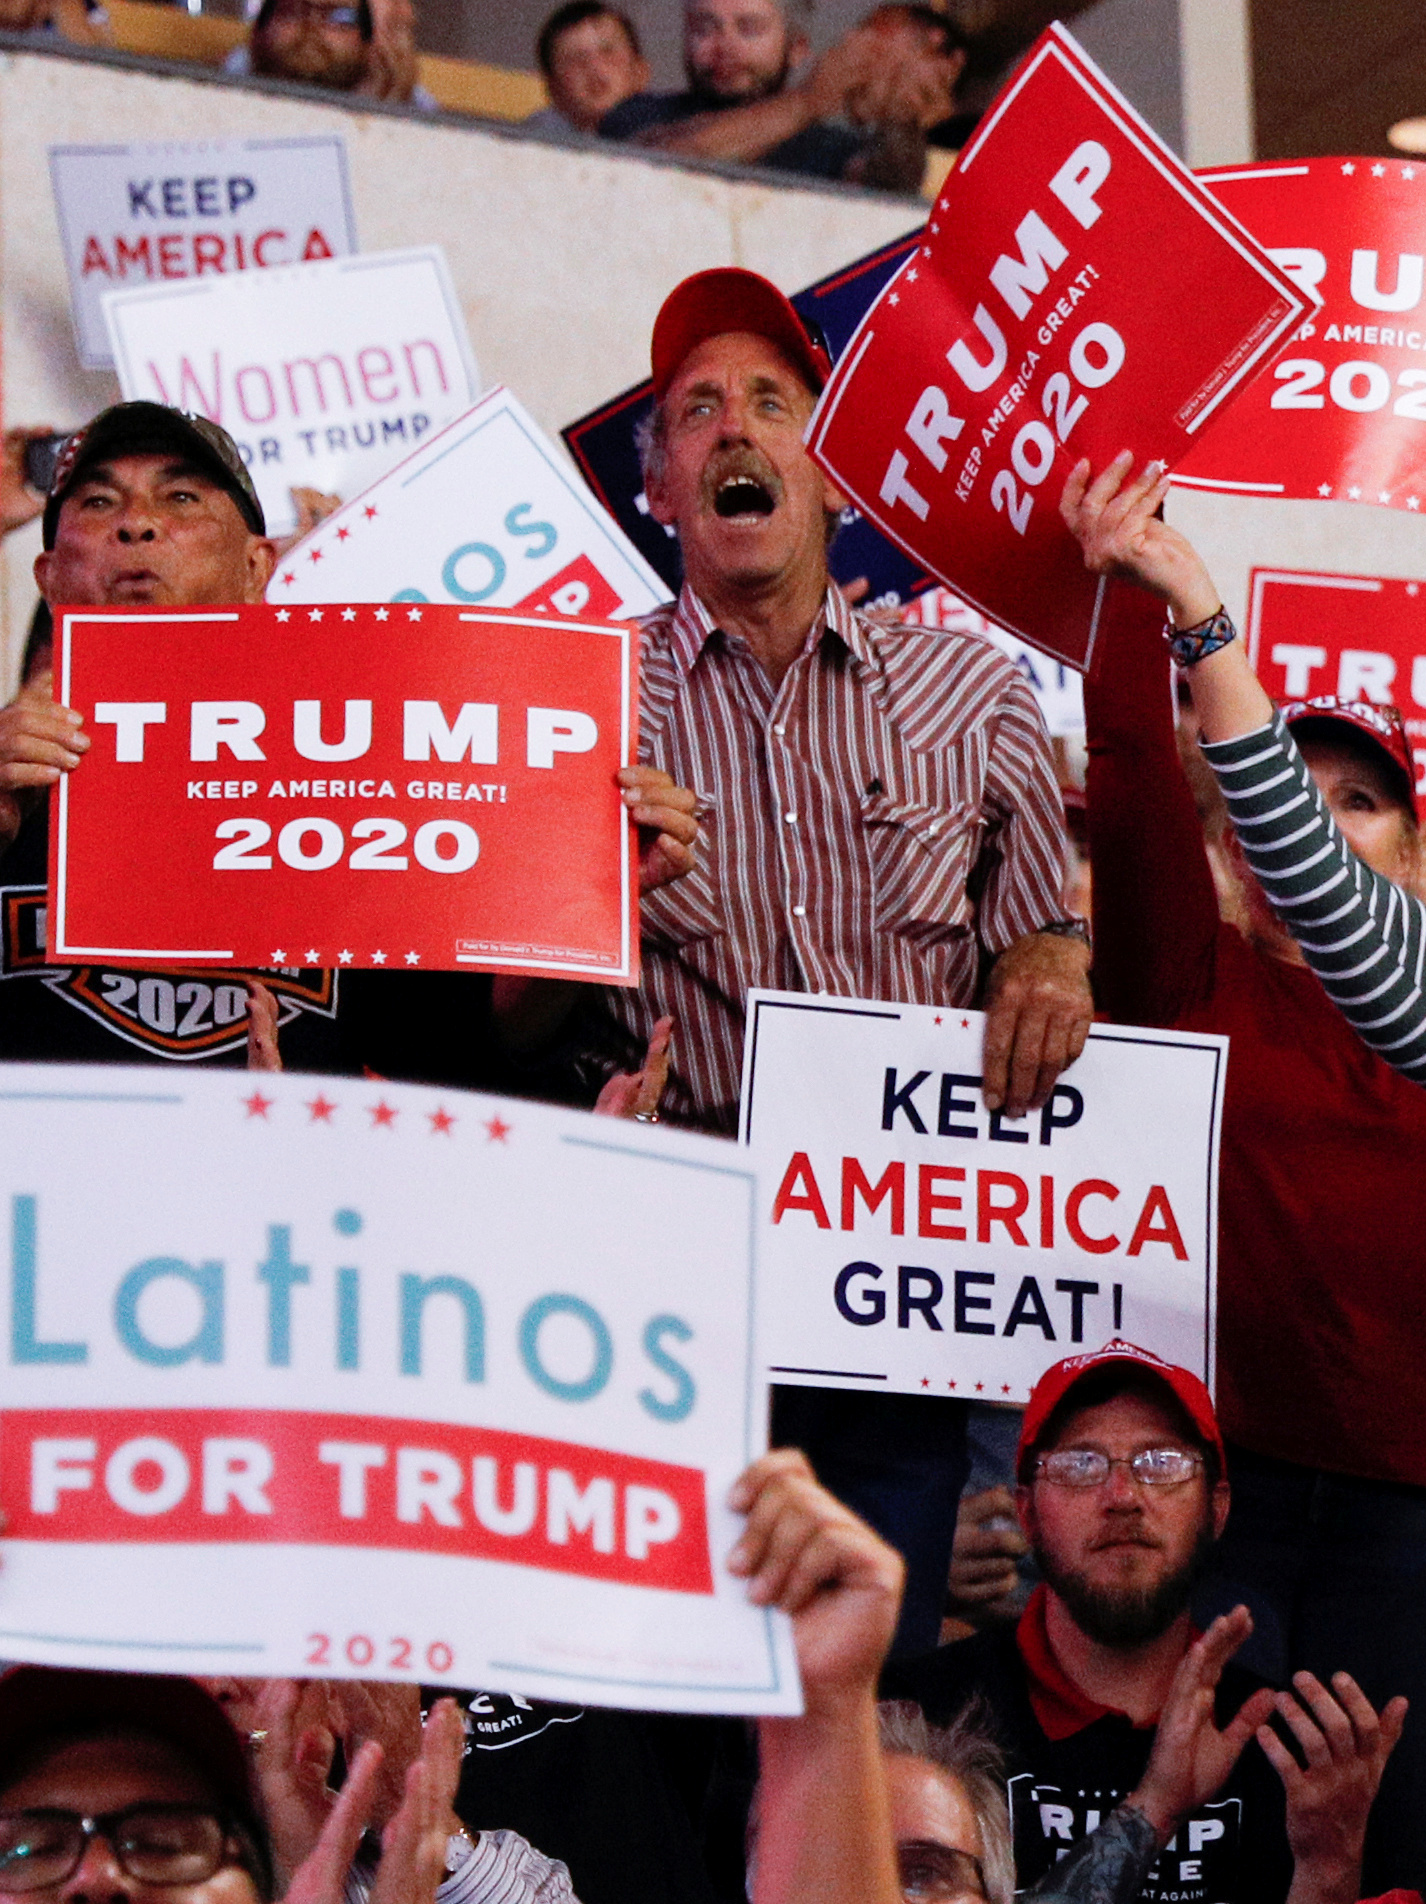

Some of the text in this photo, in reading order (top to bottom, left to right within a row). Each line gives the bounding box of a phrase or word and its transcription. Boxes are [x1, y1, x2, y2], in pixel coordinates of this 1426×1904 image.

[127, 176, 257, 219] KEEP
[81, 225, 334, 281] AMERICA
[880, 138, 1113, 522] TRUMP
[148, 338, 450, 425] Women
[955, 263, 1100, 501] KEEP AMERICA GREAT!
[238, 412, 432, 468] OR TRUMP
[990, 321, 1127, 536] 2020
[94, 699, 599, 769] TRUMP
[187, 779, 508, 804] KEEP AMERICA GREAT!
[212, 817, 481, 875] 2020
[101, 974, 249, 1037] 2020
[772, 1150, 1190, 1262] AMERICA
[9, 1193, 699, 1423] Latinos
[833, 1260, 1123, 1344] GREAT!
[29, 1434, 682, 1562] FOR TRUMP
[305, 1632, 456, 1674] 2020
[476, 1713, 524, 1734] GREAT!
